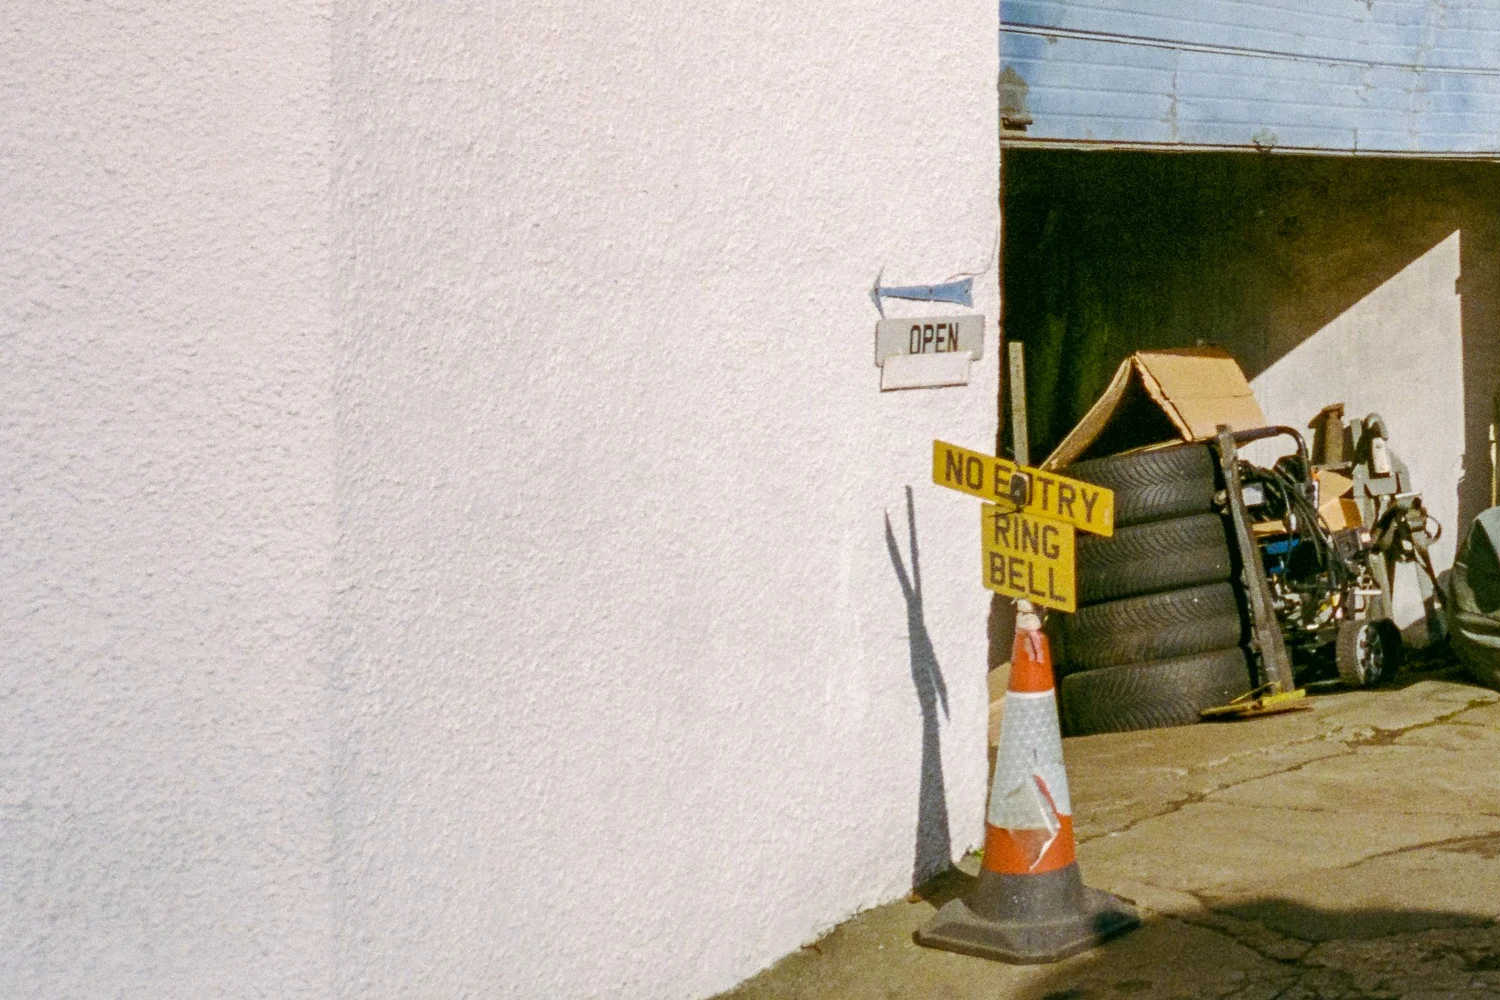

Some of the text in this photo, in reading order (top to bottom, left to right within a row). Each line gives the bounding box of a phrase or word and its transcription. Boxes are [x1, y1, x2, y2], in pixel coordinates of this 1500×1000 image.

[908, 322, 960, 354] OPEN
[944, 449, 984, 491] NO
[993, 511, 1061, 560] RING
[989, 551, 1067, 603] BELL
